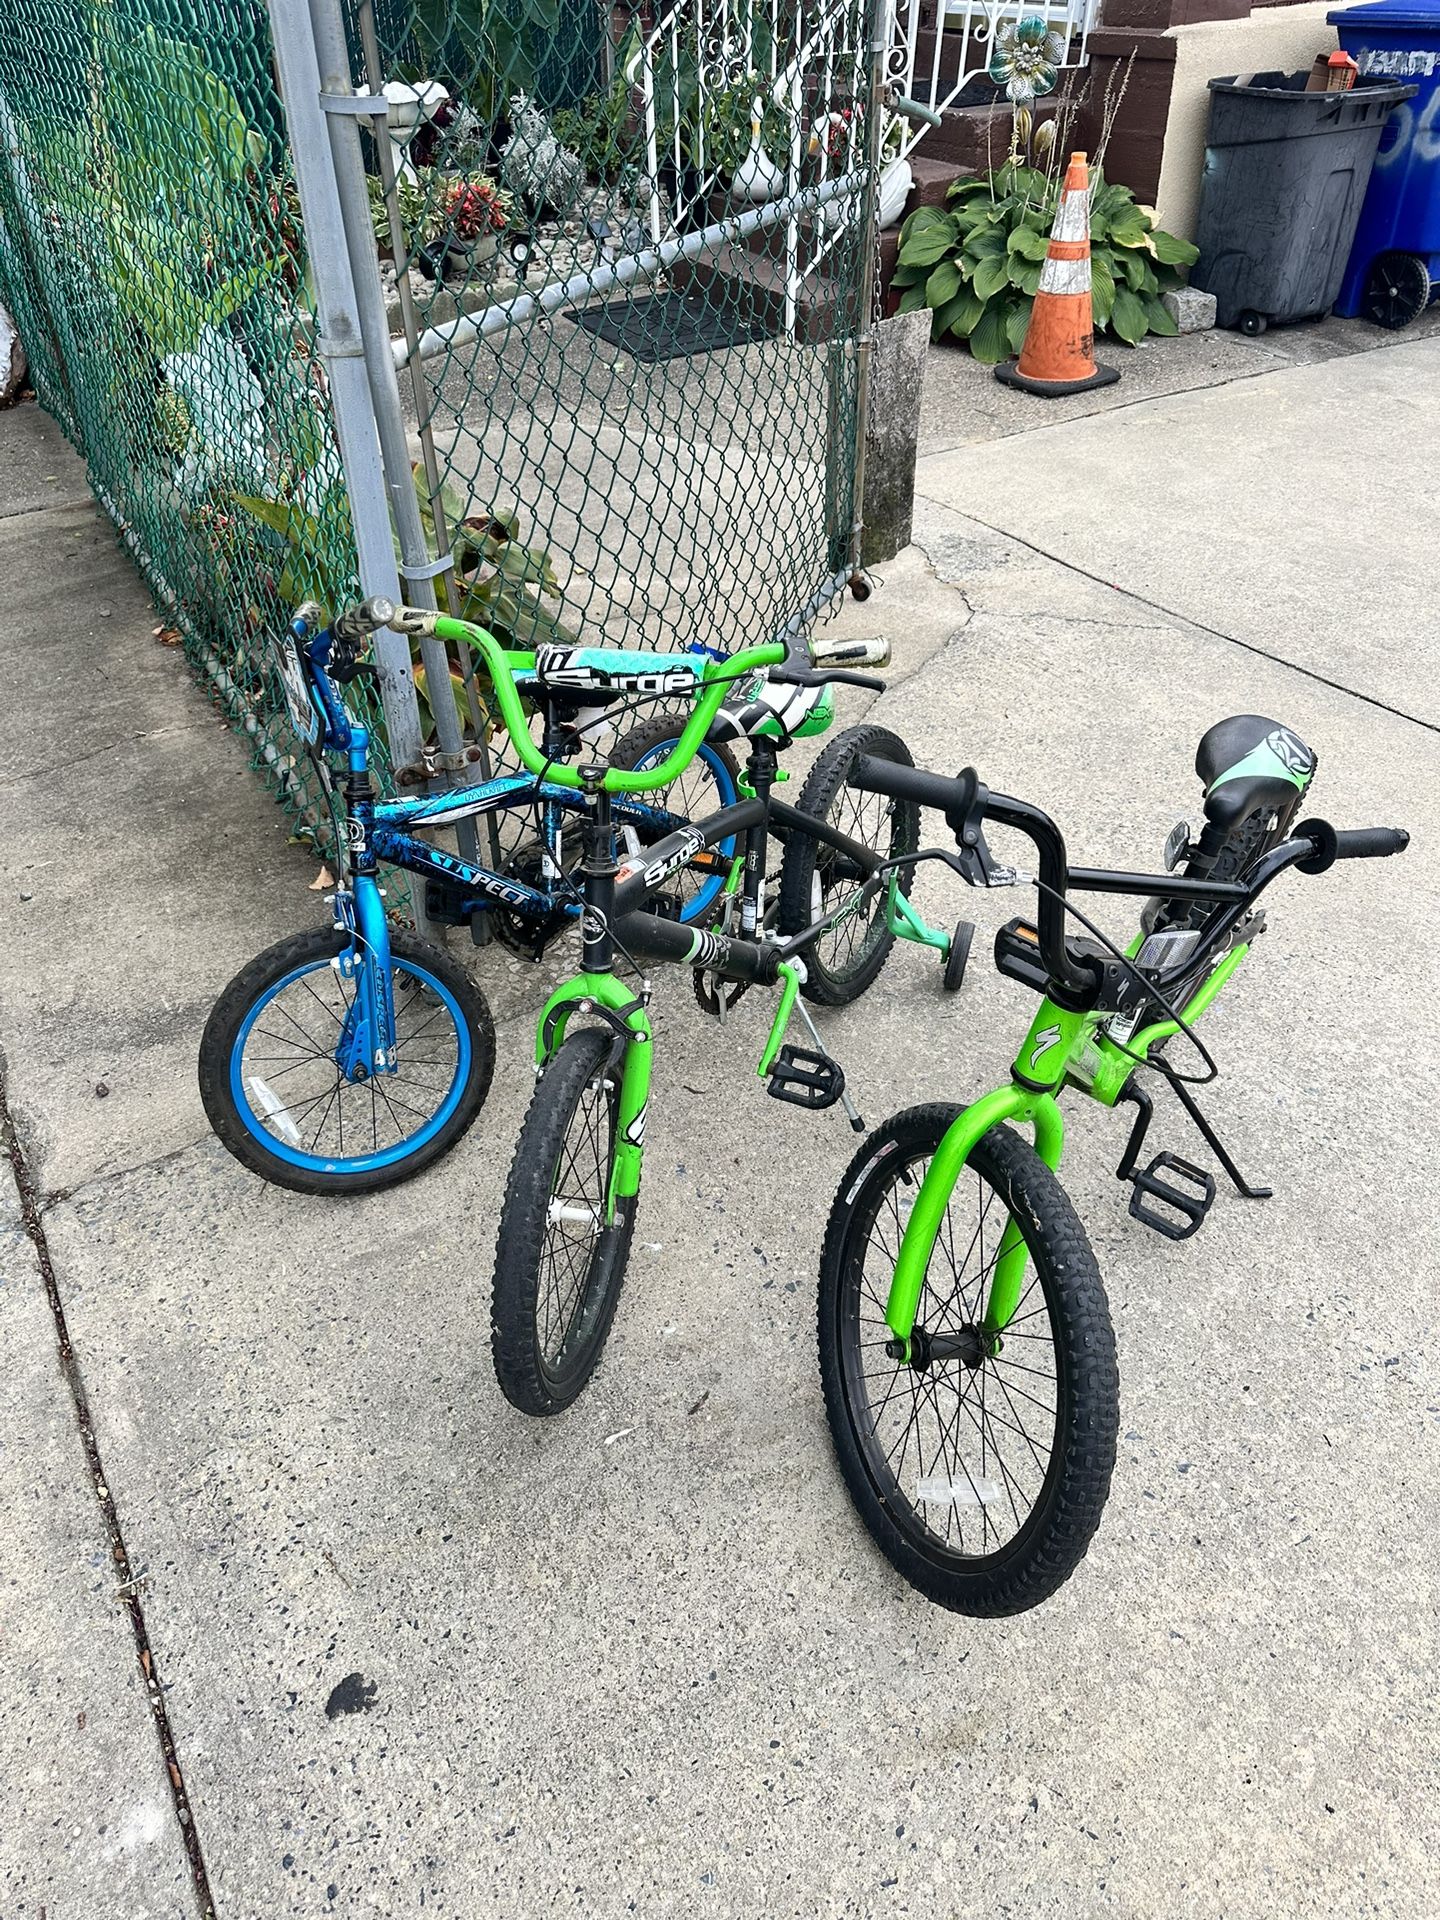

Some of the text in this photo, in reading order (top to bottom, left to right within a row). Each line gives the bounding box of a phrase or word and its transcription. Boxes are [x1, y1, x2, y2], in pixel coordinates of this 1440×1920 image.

[544, 667, 693, 694] Surge
[430, 850, 531, 906] SUSPECT
[644, 837, 700, 887] Surge
